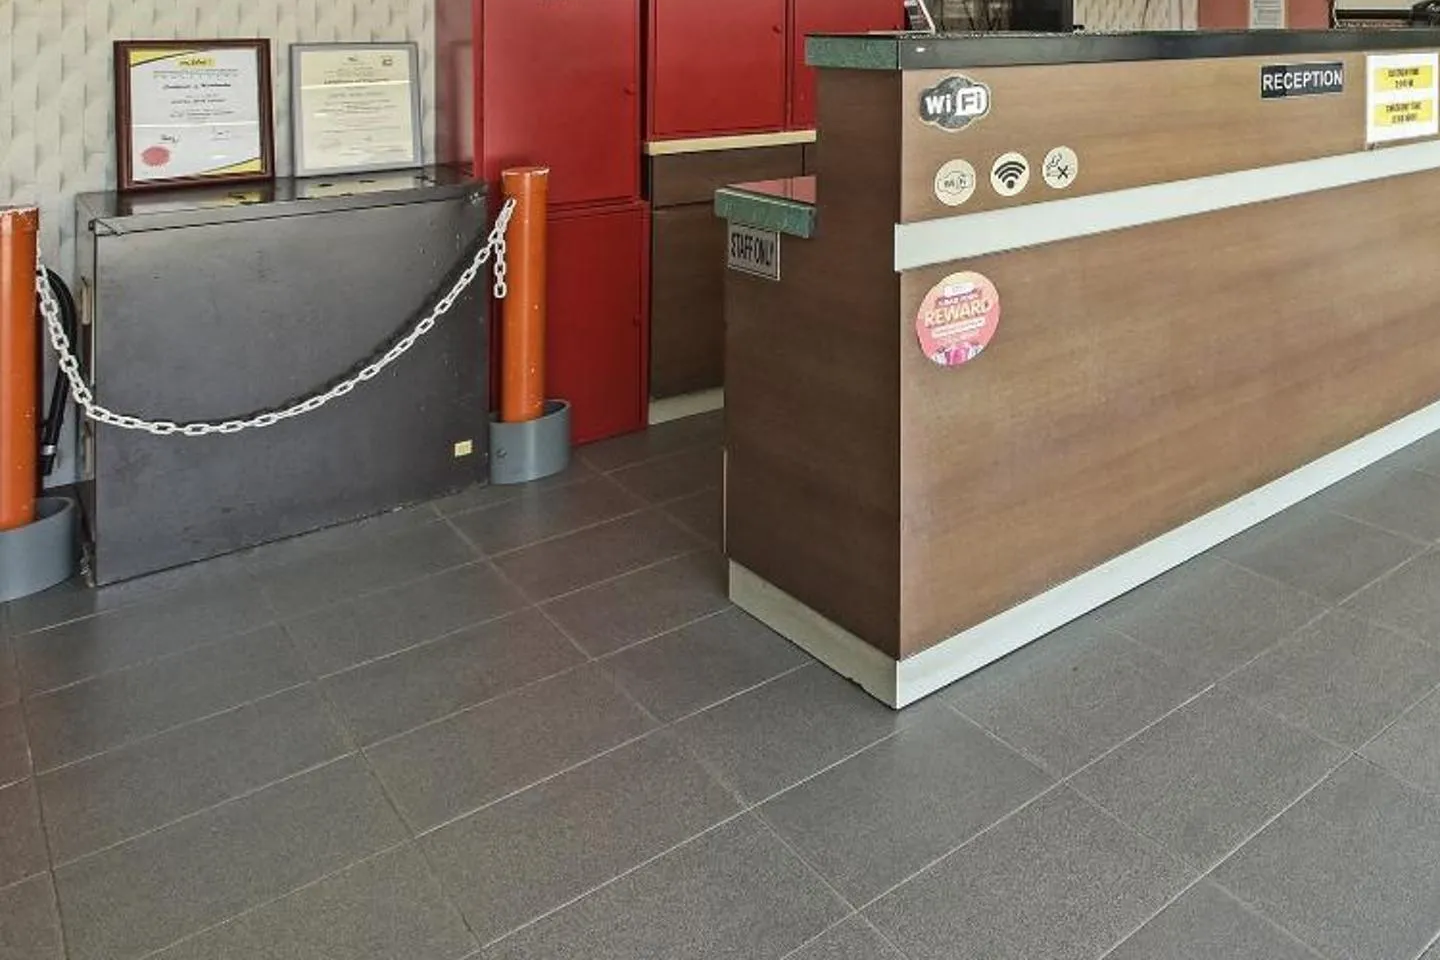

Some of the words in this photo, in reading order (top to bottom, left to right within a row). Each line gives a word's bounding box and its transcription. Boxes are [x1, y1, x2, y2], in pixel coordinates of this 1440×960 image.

[1263, 70, 1343, 91] RECEPTION
[731, 232, 753, 260] STAFF
[754, 236, 775, 266] ONLY
[924, 299, 992, 329] REWARD
